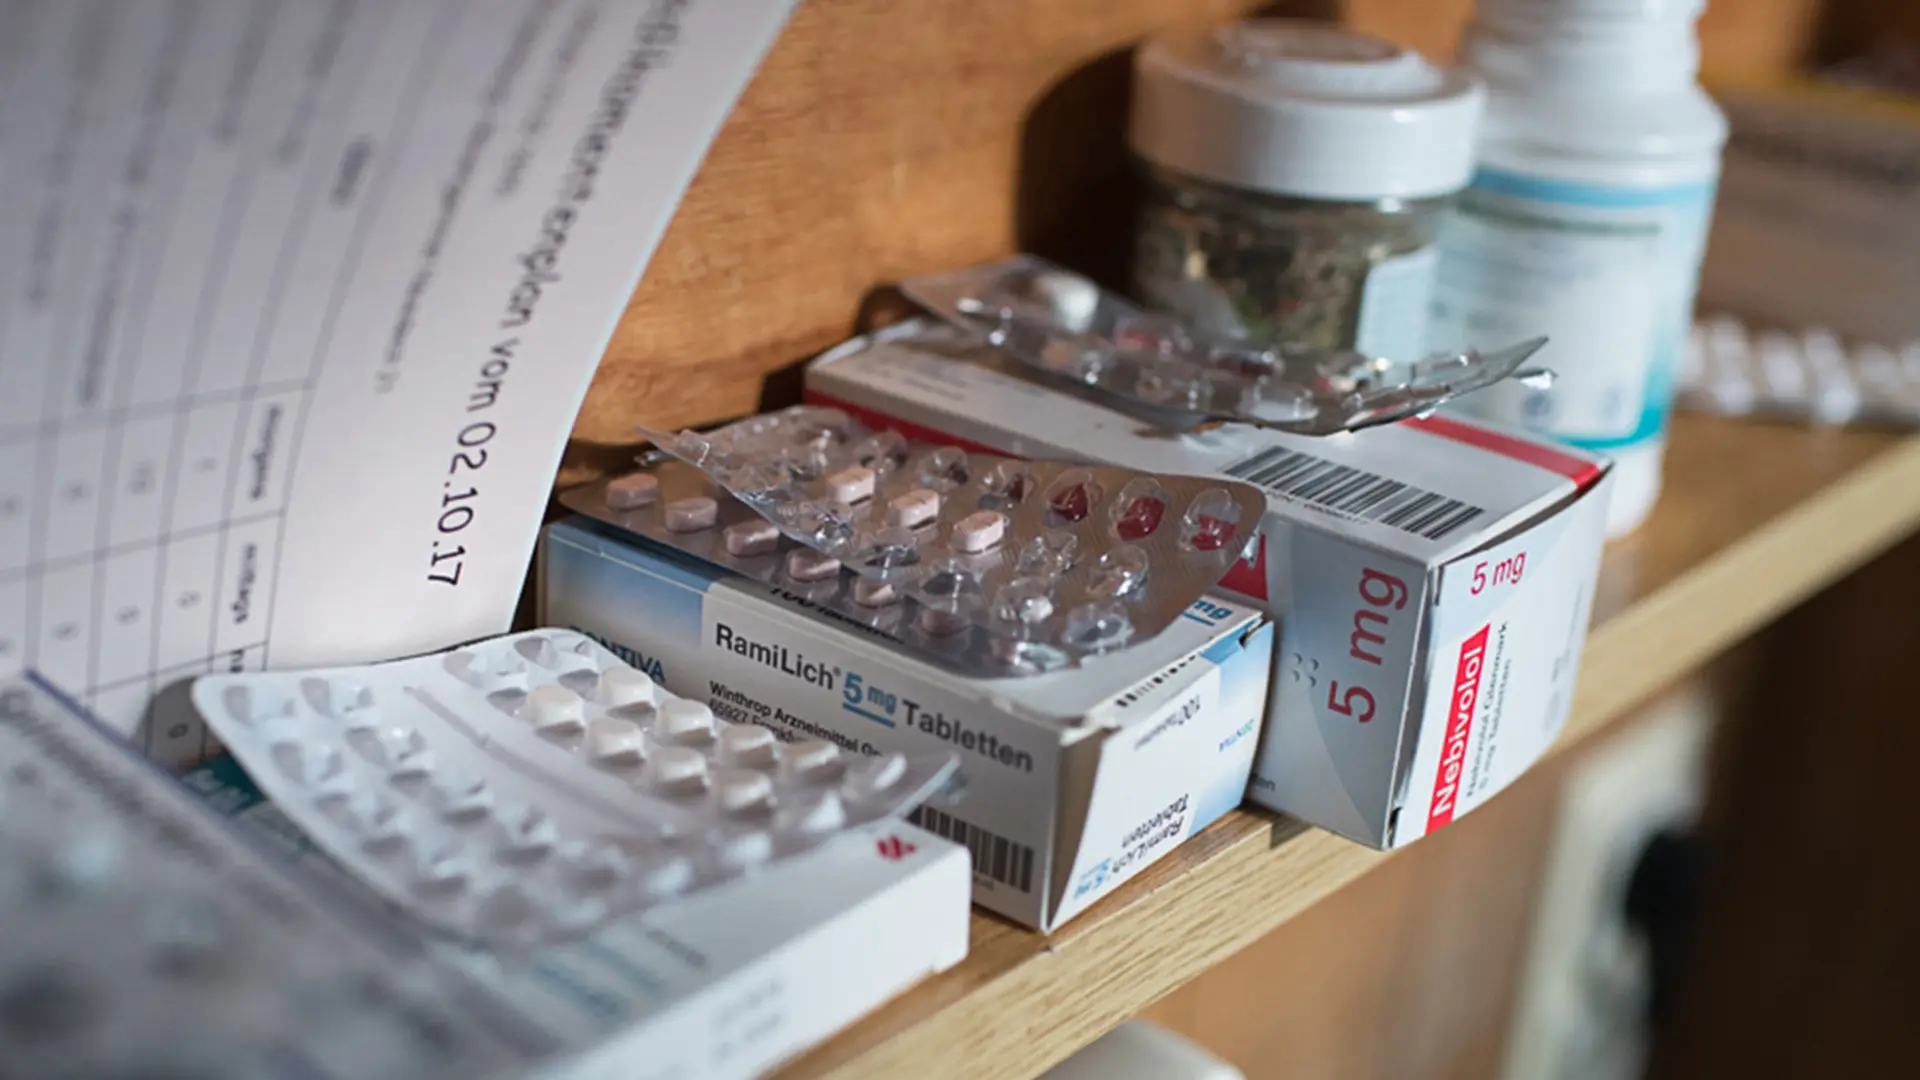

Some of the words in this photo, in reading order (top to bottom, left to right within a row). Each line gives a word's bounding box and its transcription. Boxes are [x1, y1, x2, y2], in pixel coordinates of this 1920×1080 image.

[466, 337, 520, 413] vom
[428, 421, 497, 587] 02.10.17
[1350, 567, 1409, 667] mg
[1470, 561, 1488, 596] 5
[1491, 551, 1527, 587] mg
[709, 680, 772, 718] Winthrop
[774, 708, 859, 754] Arzneimittel
[843, 672, 863, 704] 5
[867, 685, 898, 716] mg
[902, 698, 1034, 773] Tabletten
[1327, 679, 1376, 724] 5
[1432, 645, 1483, 818] Nebivolol
